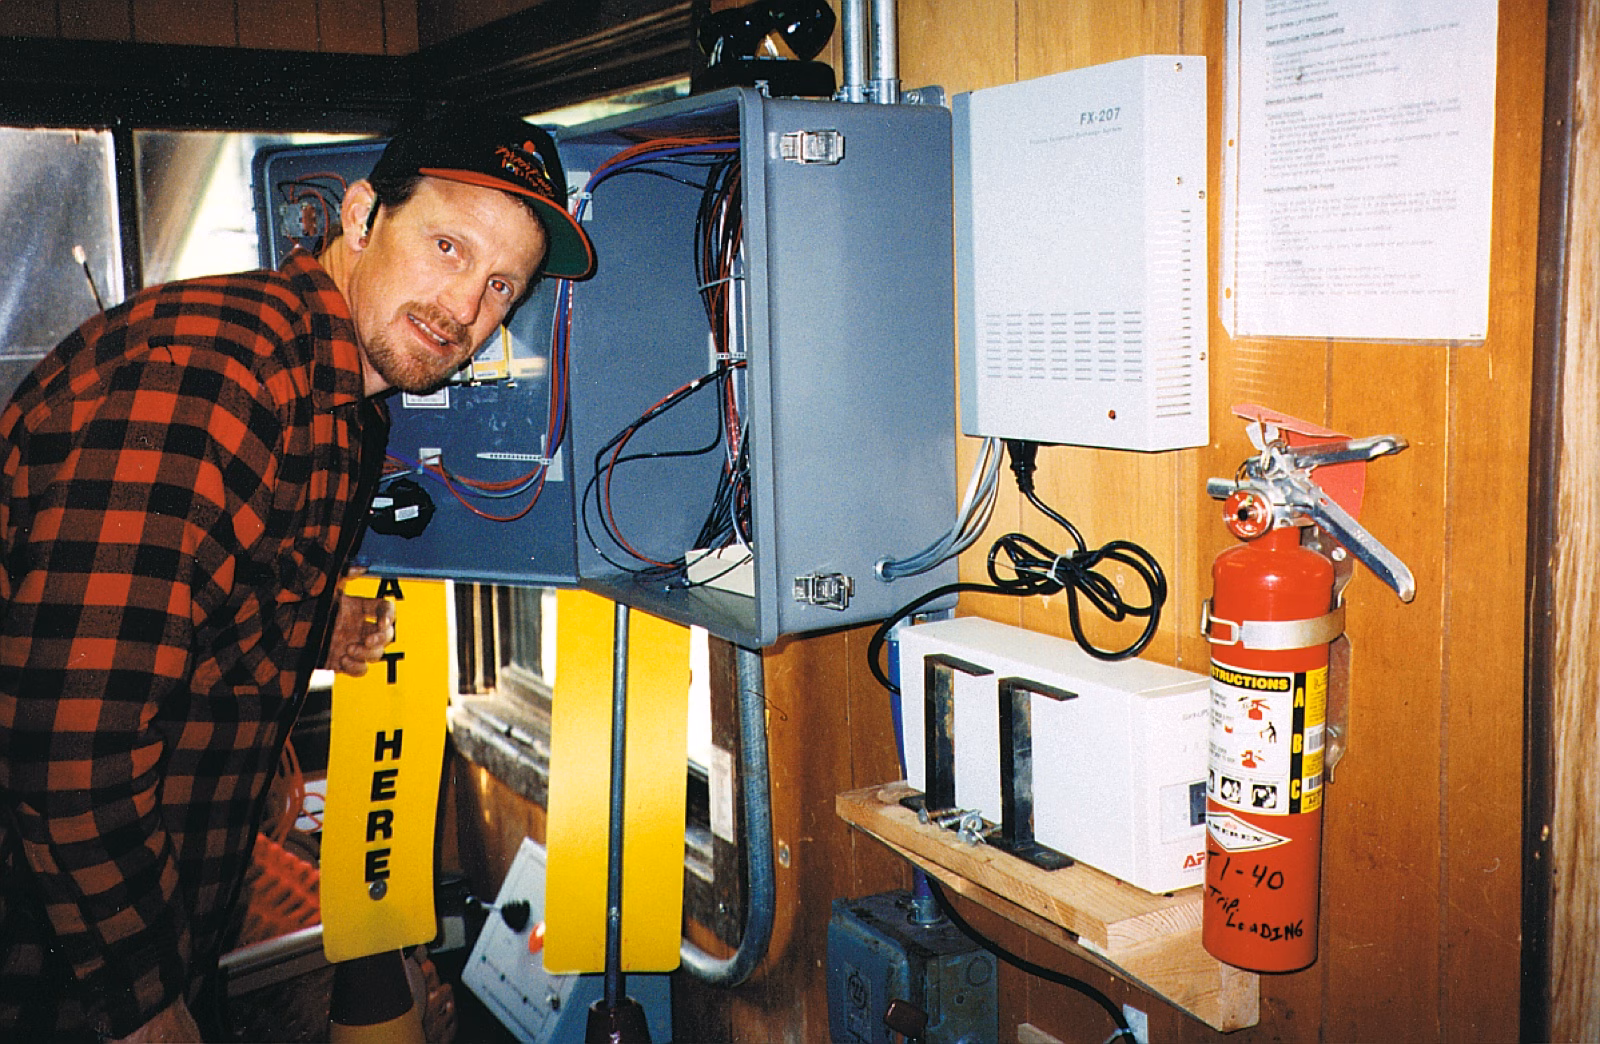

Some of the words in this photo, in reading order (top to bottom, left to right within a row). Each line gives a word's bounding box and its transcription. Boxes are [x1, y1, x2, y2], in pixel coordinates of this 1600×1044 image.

[1080, 107, 1121, 125] FX-207
[376, 577, 405, 684] AT
[1294, 687, 1304, 708] A
[1292, 733, 1303, 754] B
[1290, 779, 1301, 800] C
[365, 729, 403, 883] HERE
